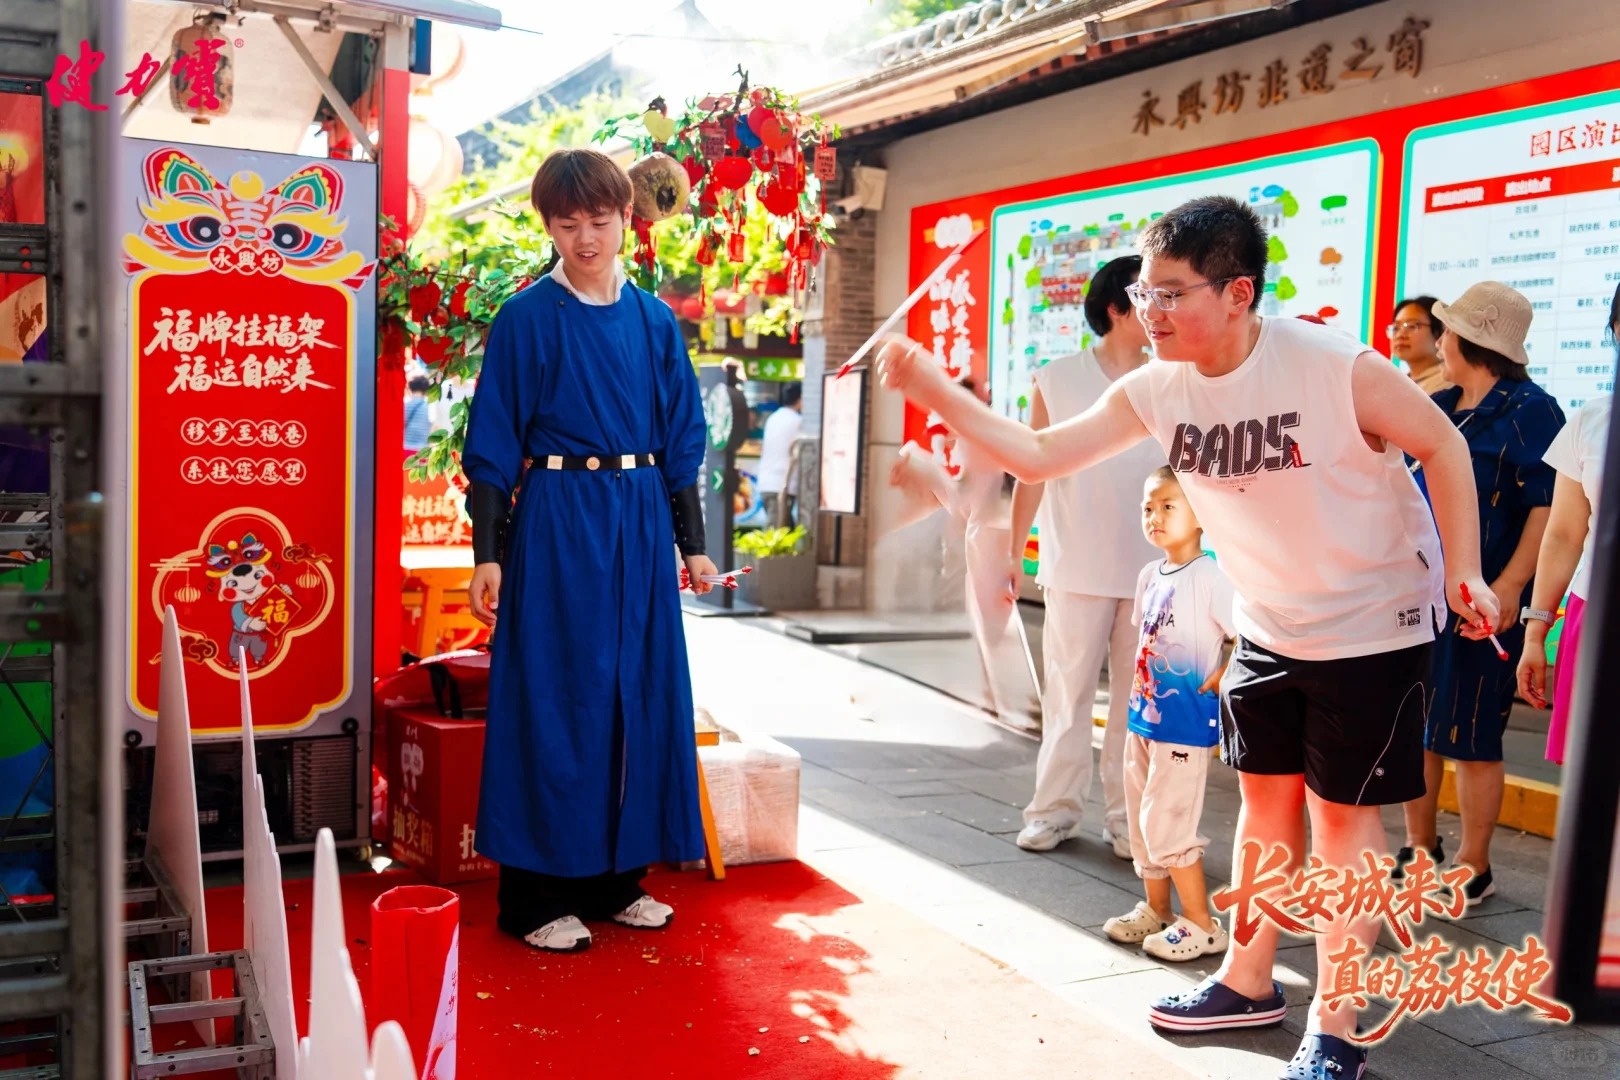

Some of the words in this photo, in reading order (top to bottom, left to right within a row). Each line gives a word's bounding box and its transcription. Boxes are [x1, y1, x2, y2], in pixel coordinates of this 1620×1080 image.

[144, 307, 342, 357] 福牌挂福架
[166, 352, 336, 394] 福运自然来
[186, 421, 302, 444] 移步至福巷
[187, 461, 301, 482] 系挂您愿望
[261, 598, 290, 624] 福
